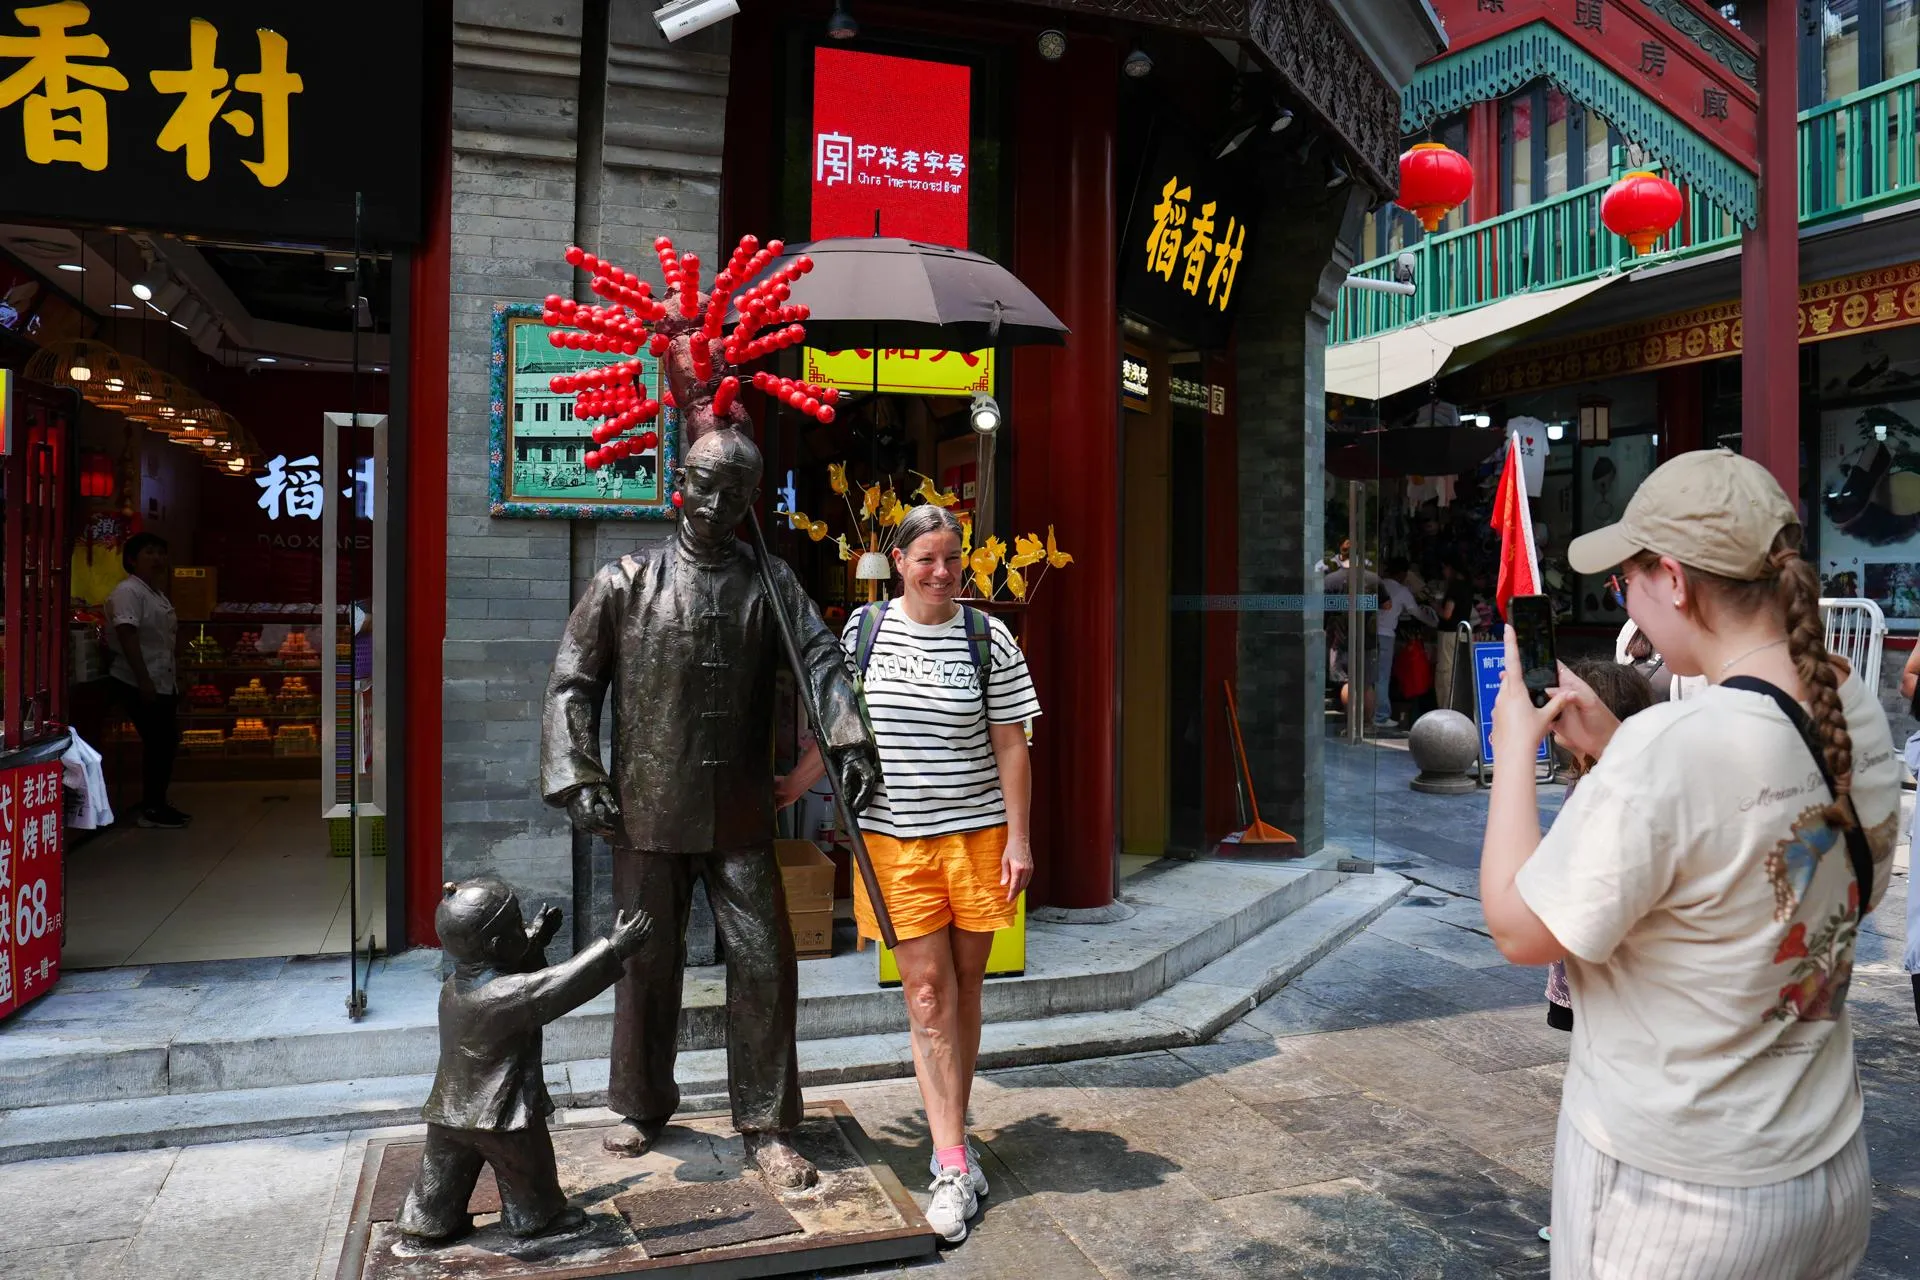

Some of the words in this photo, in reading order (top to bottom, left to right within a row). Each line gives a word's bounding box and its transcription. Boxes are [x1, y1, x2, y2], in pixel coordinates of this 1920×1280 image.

[0, 1, 303, 187] 香村
[857, 144, 966, 177] 中华老字号
[1147, 175, 1245, 311] 稻香村
[23, 771, 58, 809] 老北京
[22, 810, 57, 862] 烤鸭
[24, 957, 57, 990] 买一赠一
